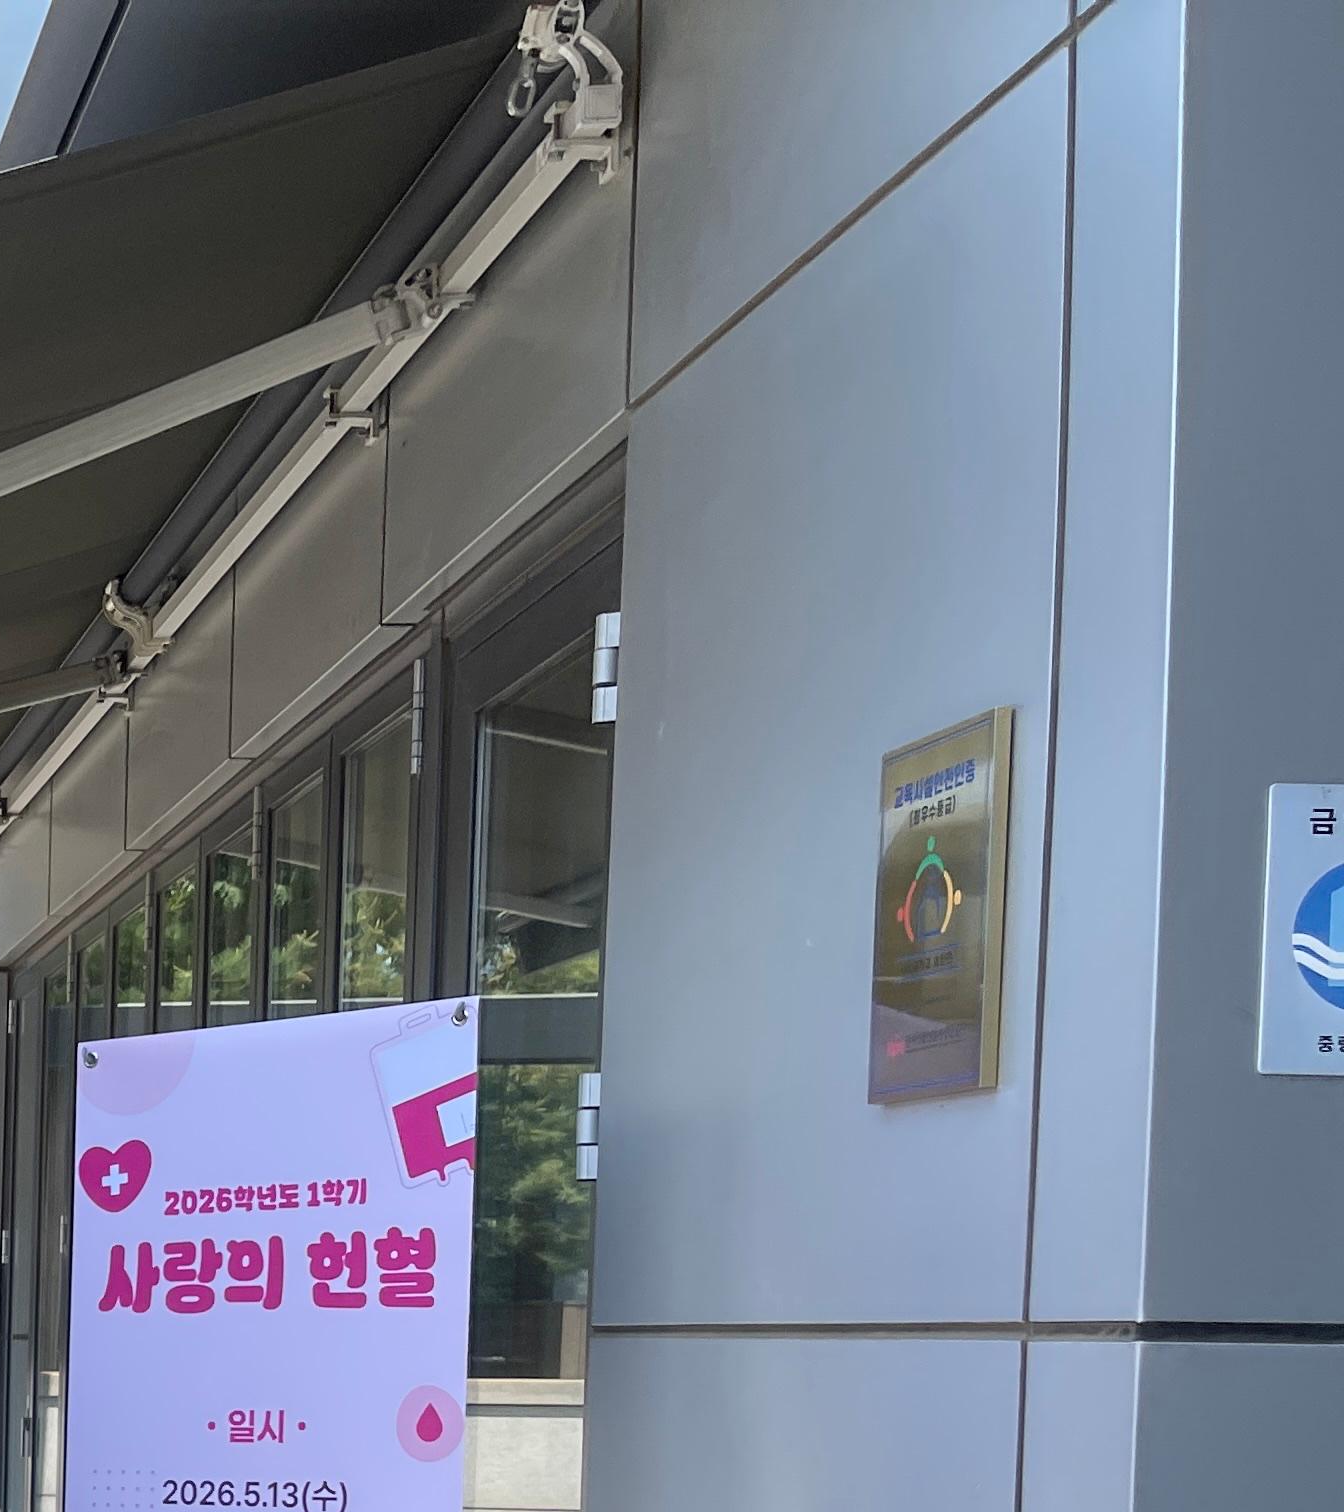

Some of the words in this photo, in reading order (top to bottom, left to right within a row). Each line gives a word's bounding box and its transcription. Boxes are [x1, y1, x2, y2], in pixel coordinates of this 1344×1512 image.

[164, 1184, 300, 1216] 2026학년도
[307, 1177, 367, 1208] 1학기
[98, 1235, 285, 1313] 사랑의
[307, 1226, 437, 1309] 헌혈
[228, 1409, 285, 1444] 일시
